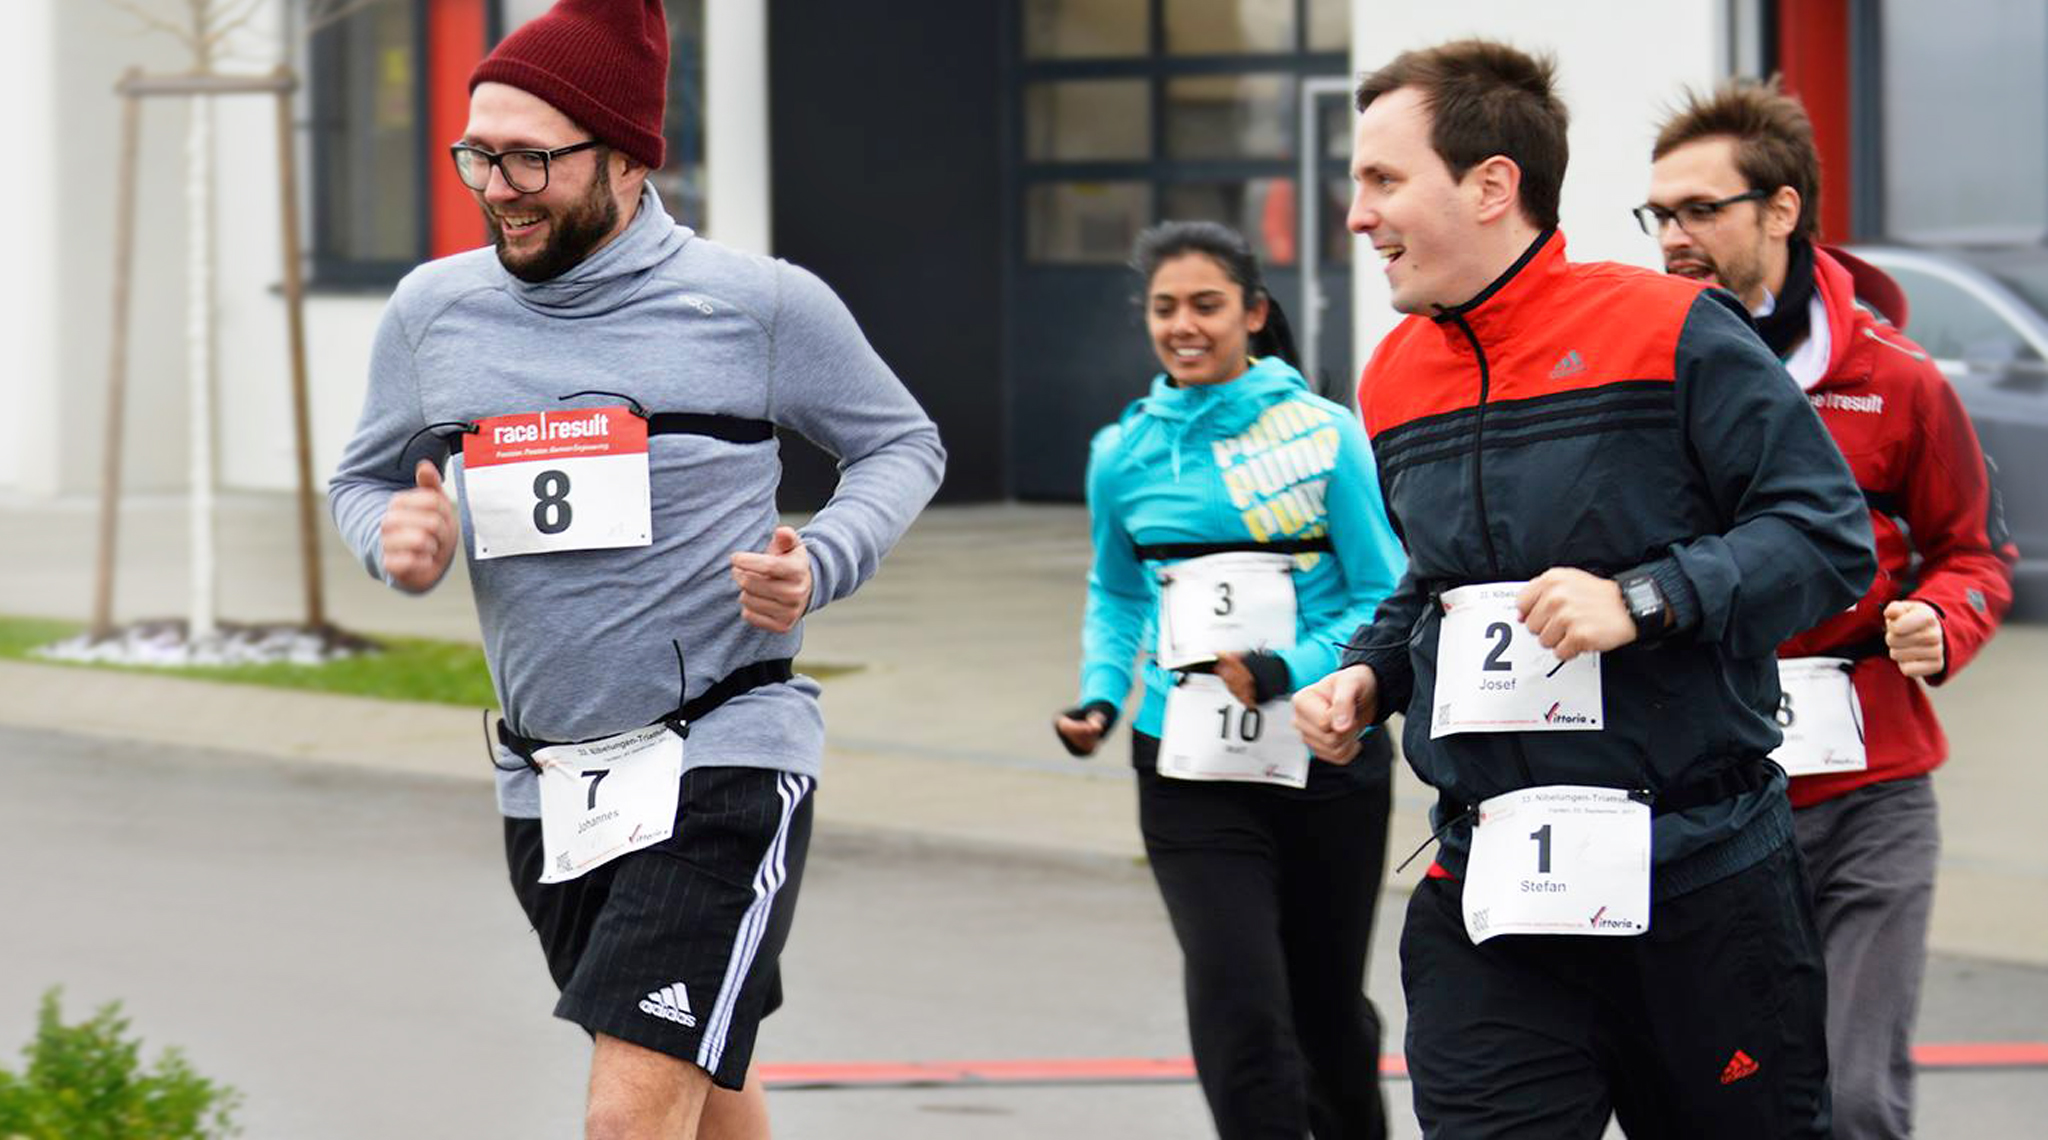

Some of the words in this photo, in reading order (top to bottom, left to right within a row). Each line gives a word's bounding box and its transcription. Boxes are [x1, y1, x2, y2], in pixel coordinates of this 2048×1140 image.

[533, 469, 573, 535] 8
[1213, 582, 1234, 616] 3
[1482, 621, 1513, 672] 2
[1479, 677, 1517, 691] Josef
[1218, 704, 1264, 742] 10
[581, 768, 611, 811] 7
[578, 809, 620, 835] Johannes
[1530, 824, 1552, 874] 1
[1520, 880, 1567, 893] Stefan
[638, 999, 697, 1028] adidas
